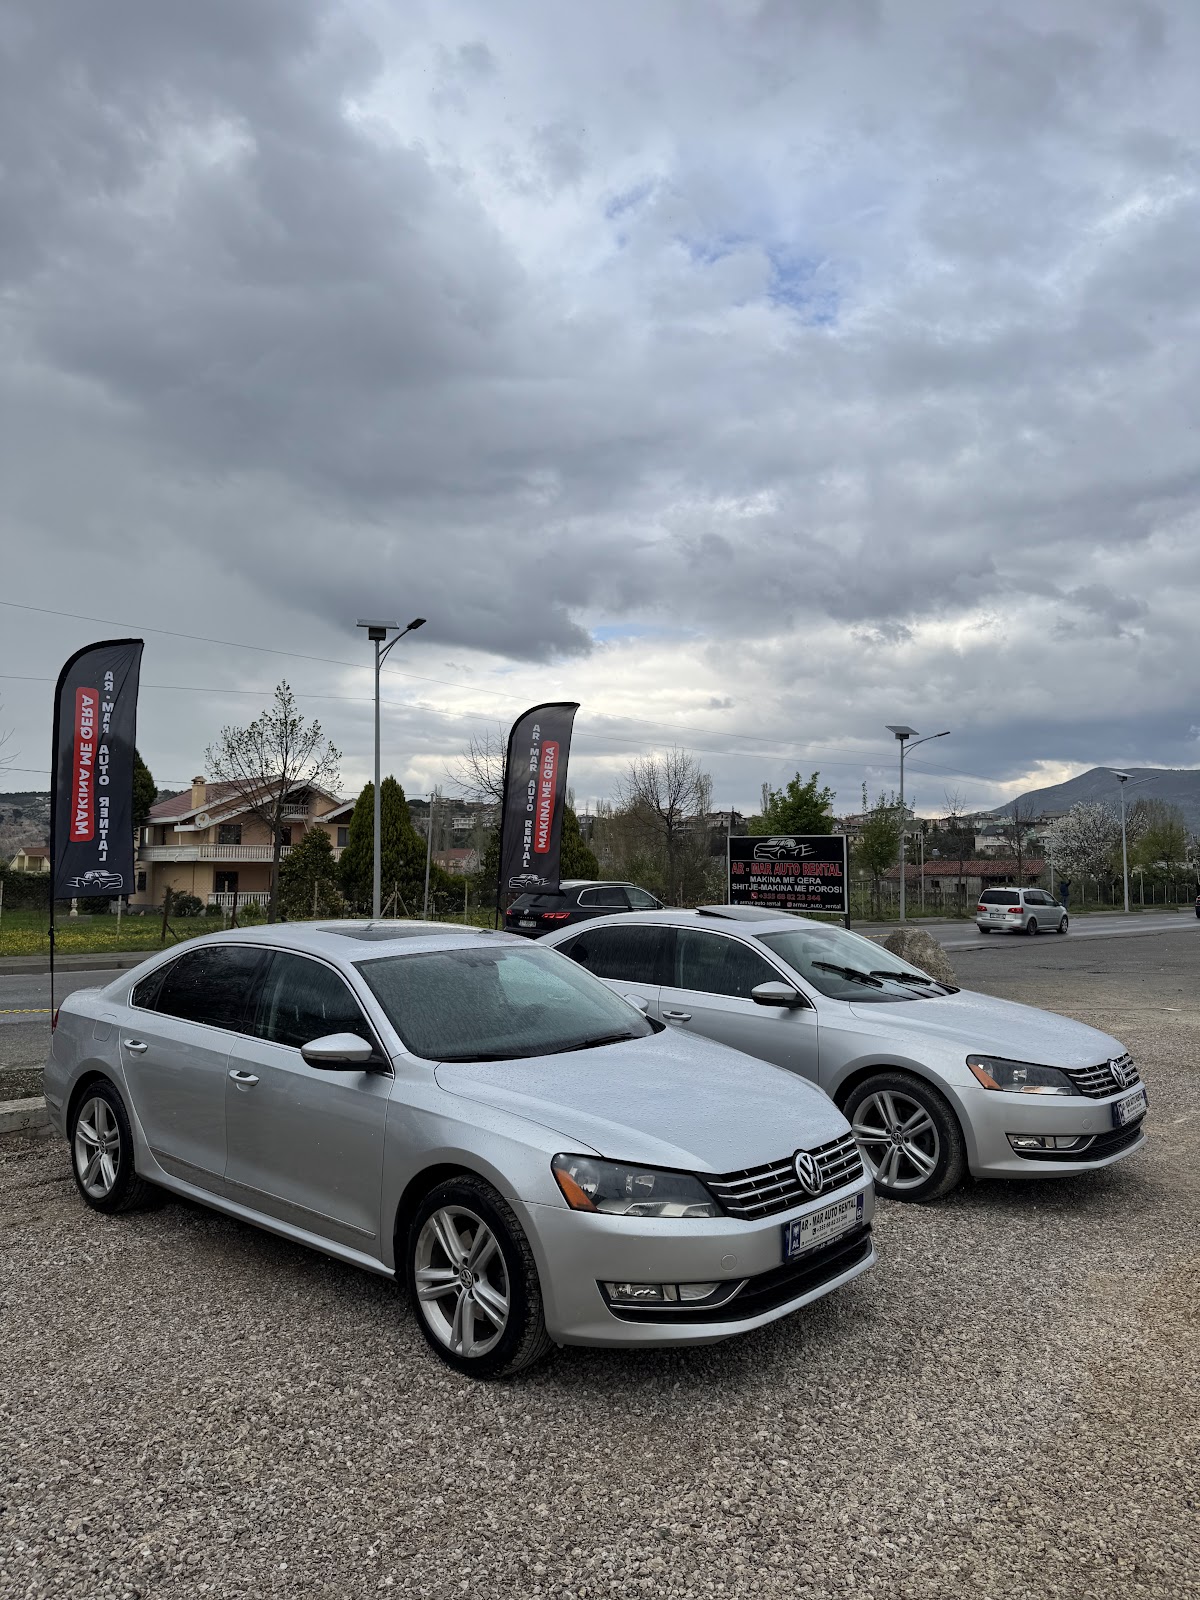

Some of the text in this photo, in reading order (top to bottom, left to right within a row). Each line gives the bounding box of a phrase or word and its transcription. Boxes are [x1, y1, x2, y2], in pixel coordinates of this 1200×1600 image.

[526, 779, 536, 812] AUTO
[538, 746, 555, 848] MAKINA ME QERA
[522, 819, 533, 868] RENTAL
[731, 862, 745, 875] AR
[751, 862, 772, 875] MAR
[774, 863, 800, 876] AUTO
[802, 863, 843, 877] RENTAL
[749, 876, 822, 885] MAKINA ME QERA
[731, 883, 793, 892] SHITJE-MAKINA
[808, 885, 843, 894] POROSI
[801, 1219, 809, 1232] AR
[824, 1206, 838, 1220] AUTO
